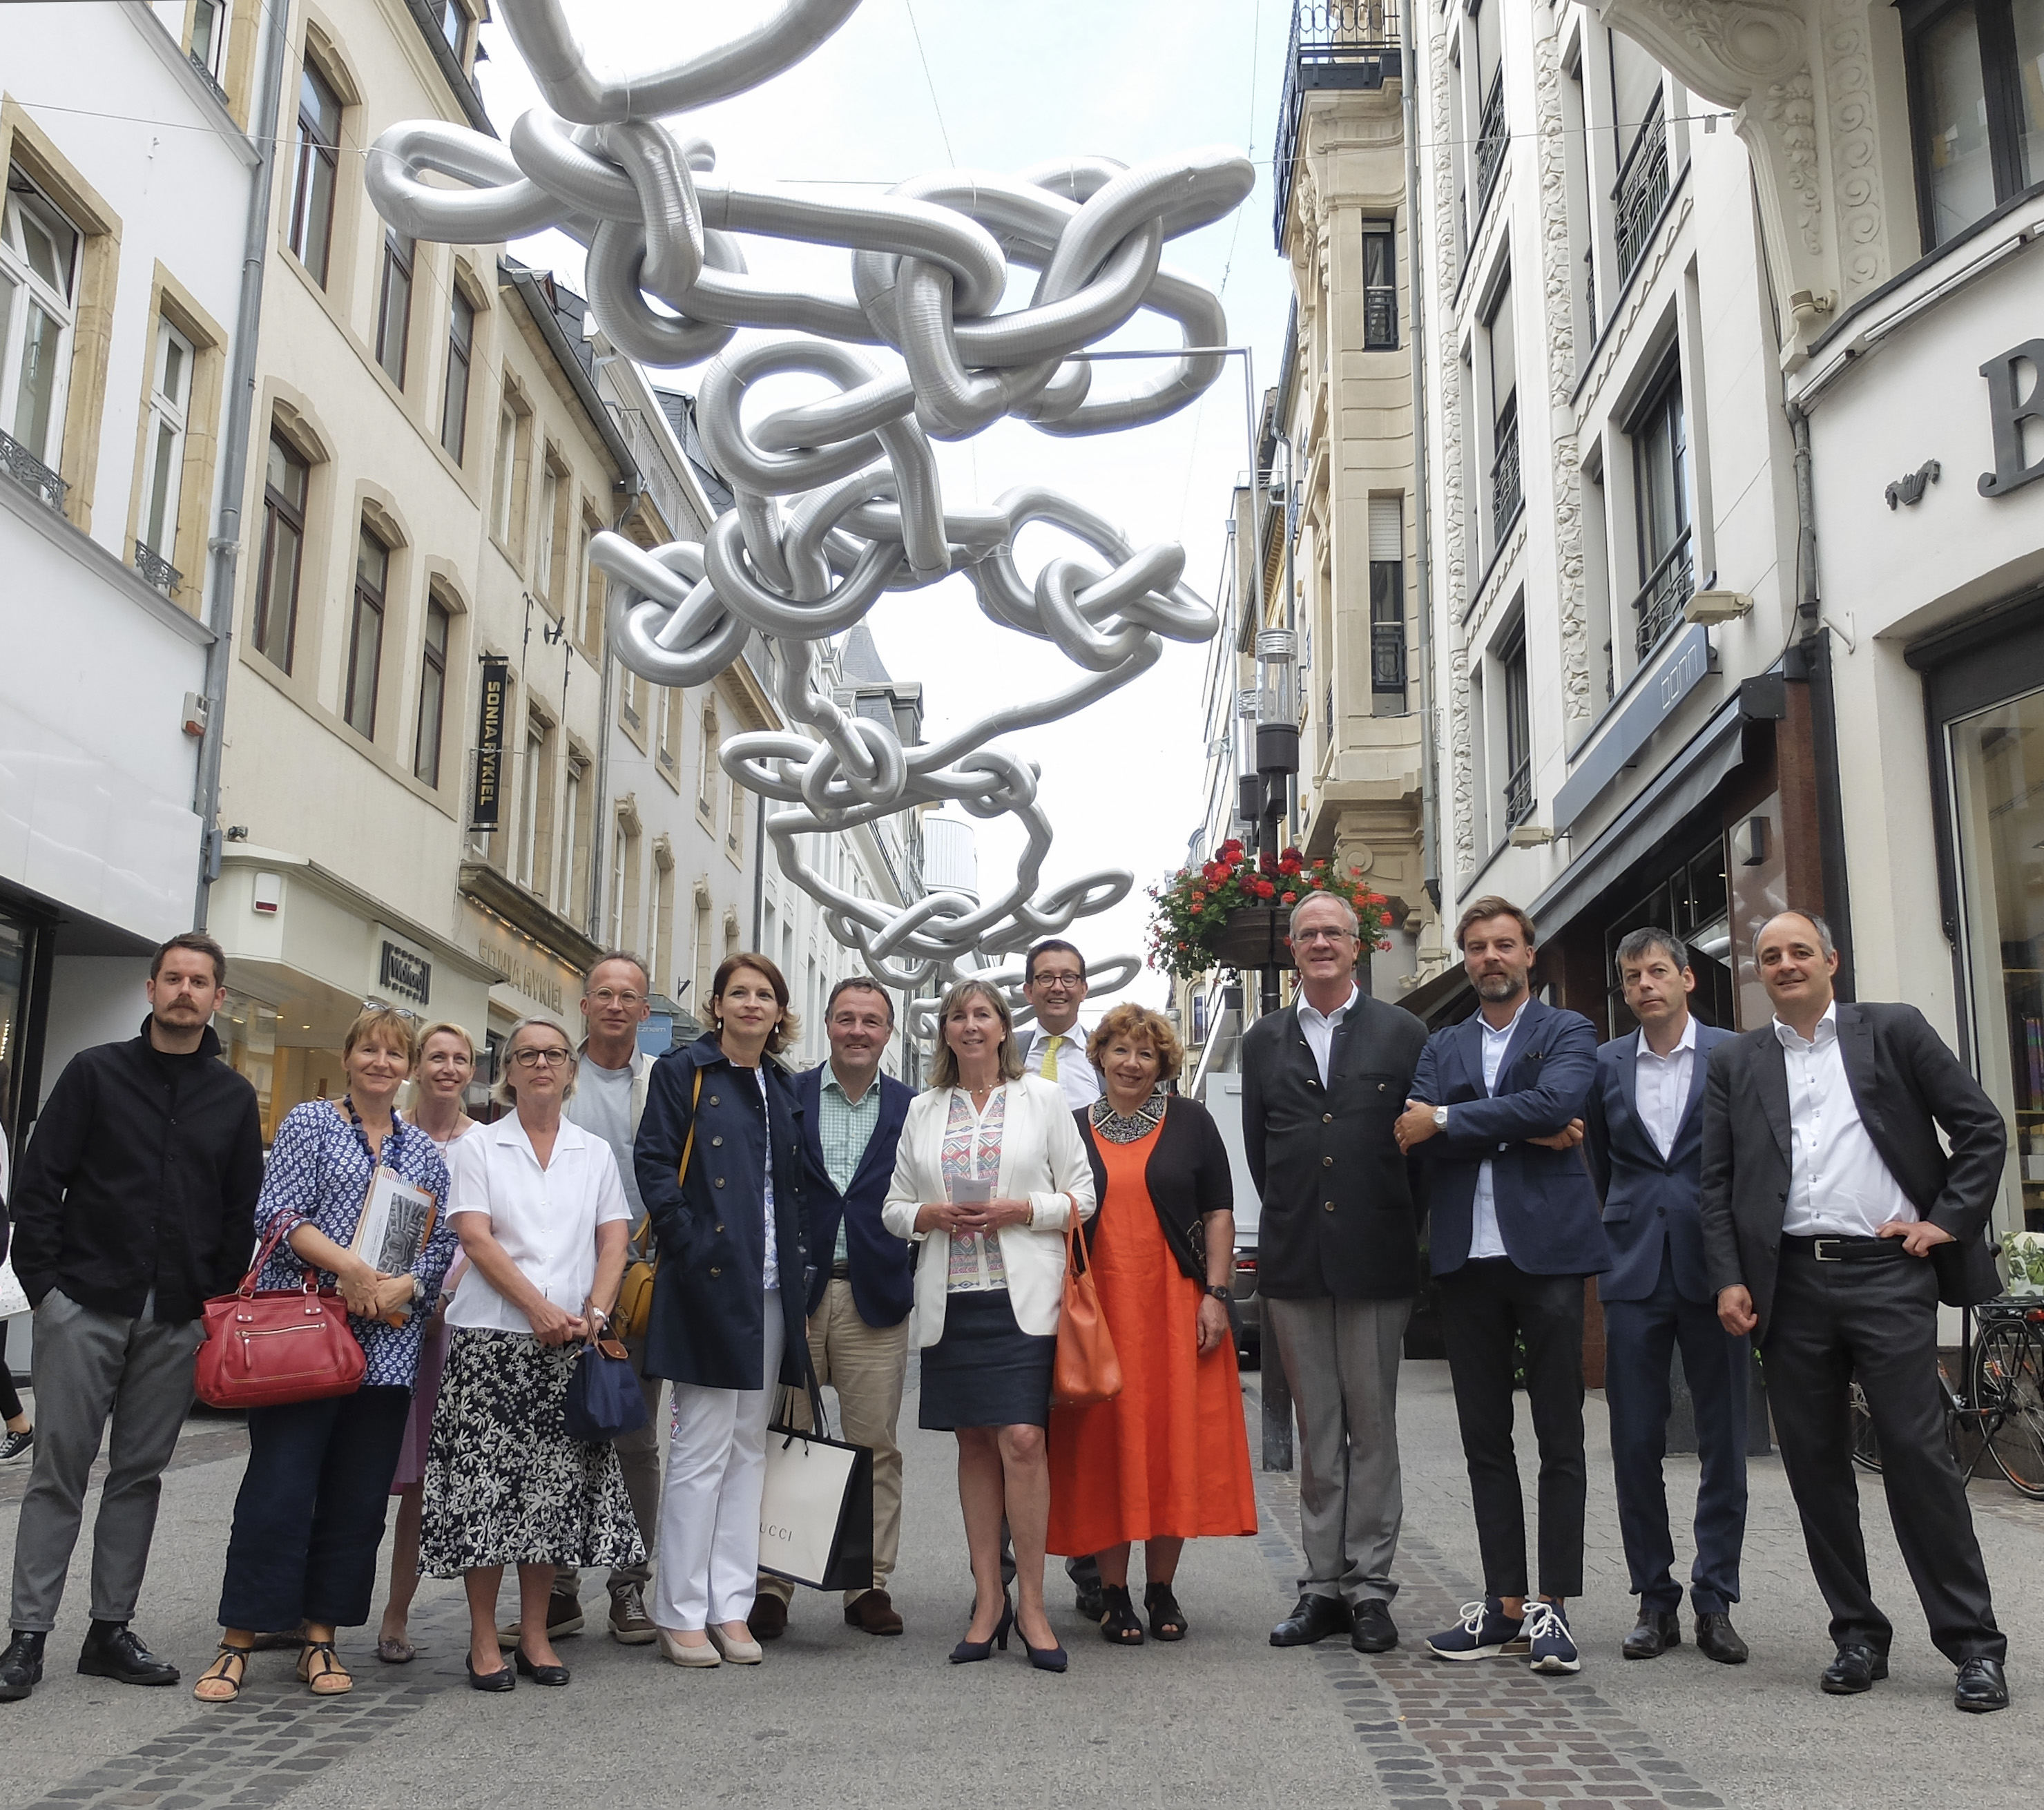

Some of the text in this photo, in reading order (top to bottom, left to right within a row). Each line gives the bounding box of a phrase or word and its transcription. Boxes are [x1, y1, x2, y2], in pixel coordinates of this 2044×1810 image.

[1660, 644, 1697, 710] bonn
[481, 681, 501, 806] SONIA RYKIEL
[390, 955, 423, 991] Wolford
[523, 965, 564, 1017] RYKIEL
[760, 1521, 792, 1542] UCCI
